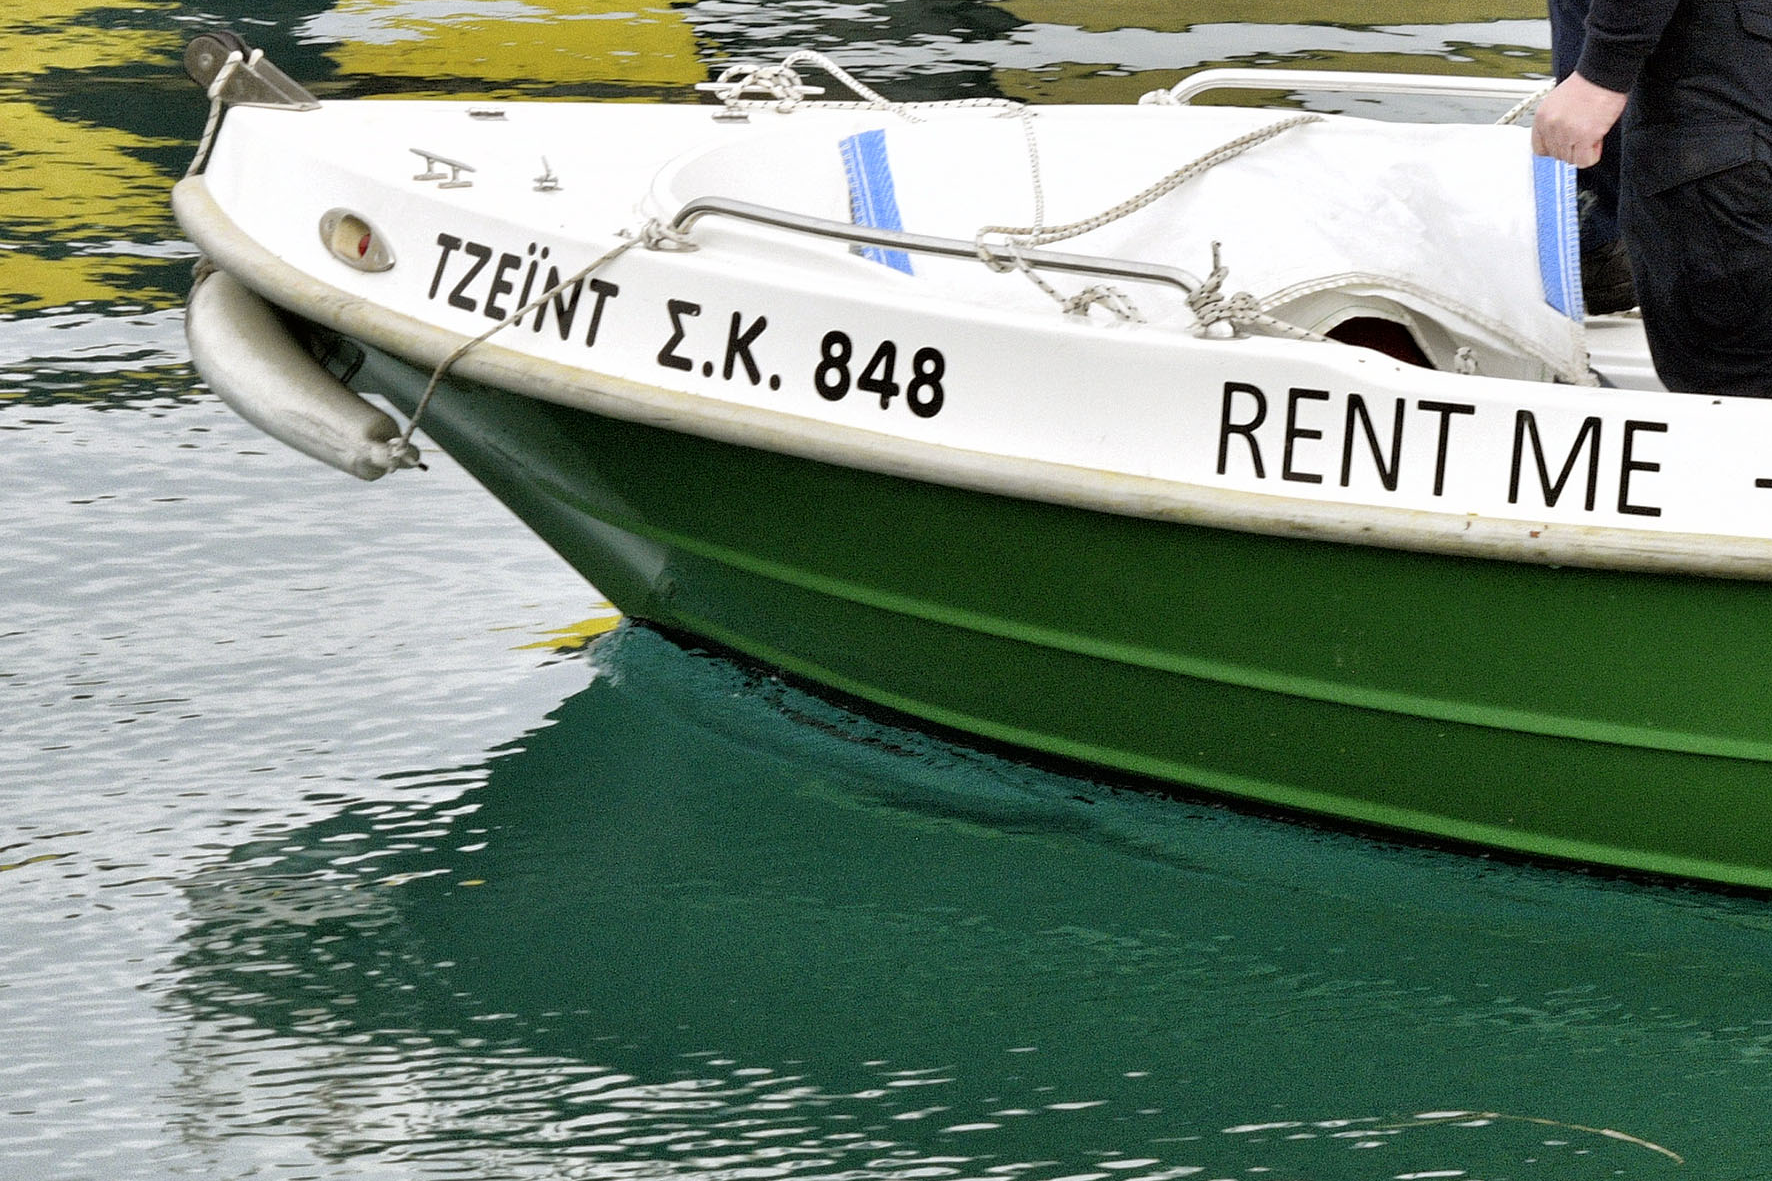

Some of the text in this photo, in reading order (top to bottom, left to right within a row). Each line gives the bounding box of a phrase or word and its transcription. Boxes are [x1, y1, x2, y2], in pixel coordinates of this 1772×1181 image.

[814, 330, 946, 419] 848
[1216, 381, 1476, 497] RENT
[1507, 409, 1668, 518] ME
